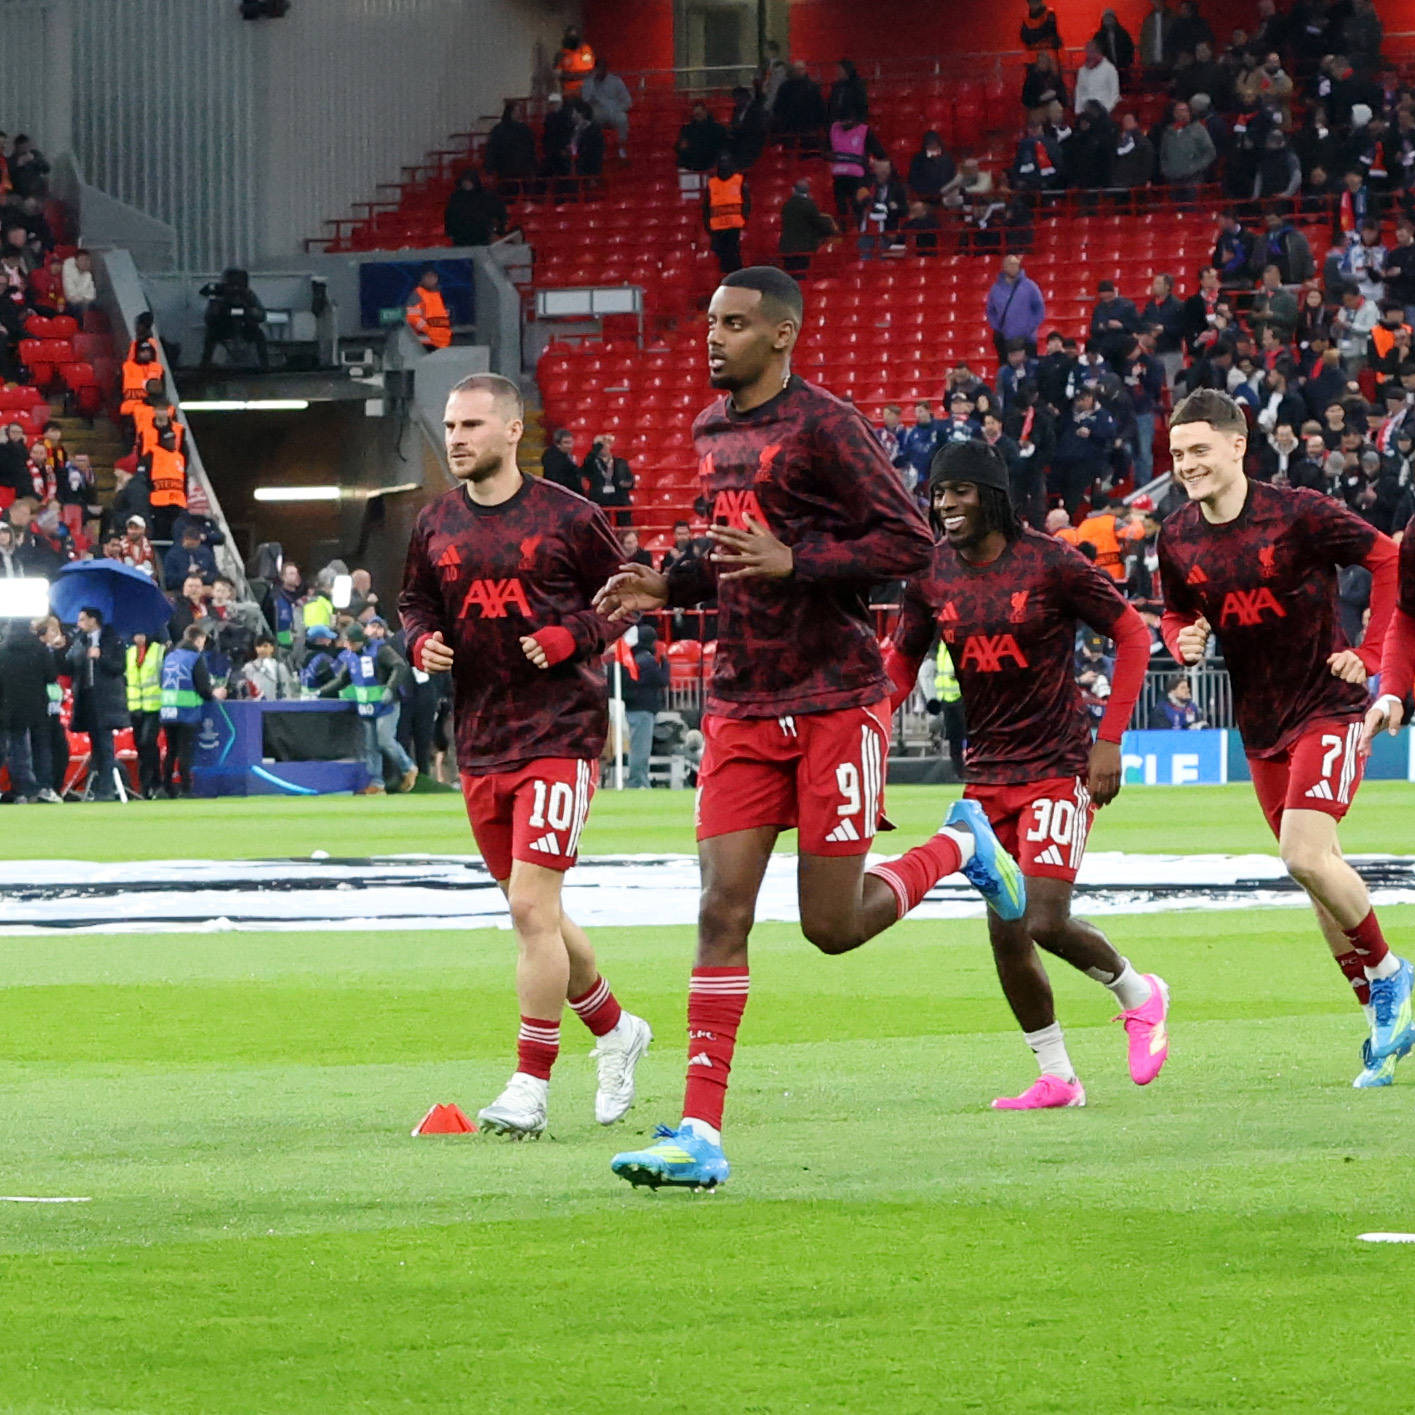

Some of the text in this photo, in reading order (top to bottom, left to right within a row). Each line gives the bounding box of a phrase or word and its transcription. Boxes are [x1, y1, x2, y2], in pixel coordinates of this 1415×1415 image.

[712, 489, 771, 531] AXA
[458, 578, 533, 620] AXA
[1221, 586, 1288, 627] AXA
[960, 633, 1029, 672] AXA
[1321, 734, 1343, 777] 7
[528, 779, 573, 831] 10
[835, 762, 861, 816] 9
[1026, 797, 1076, 846] 30
